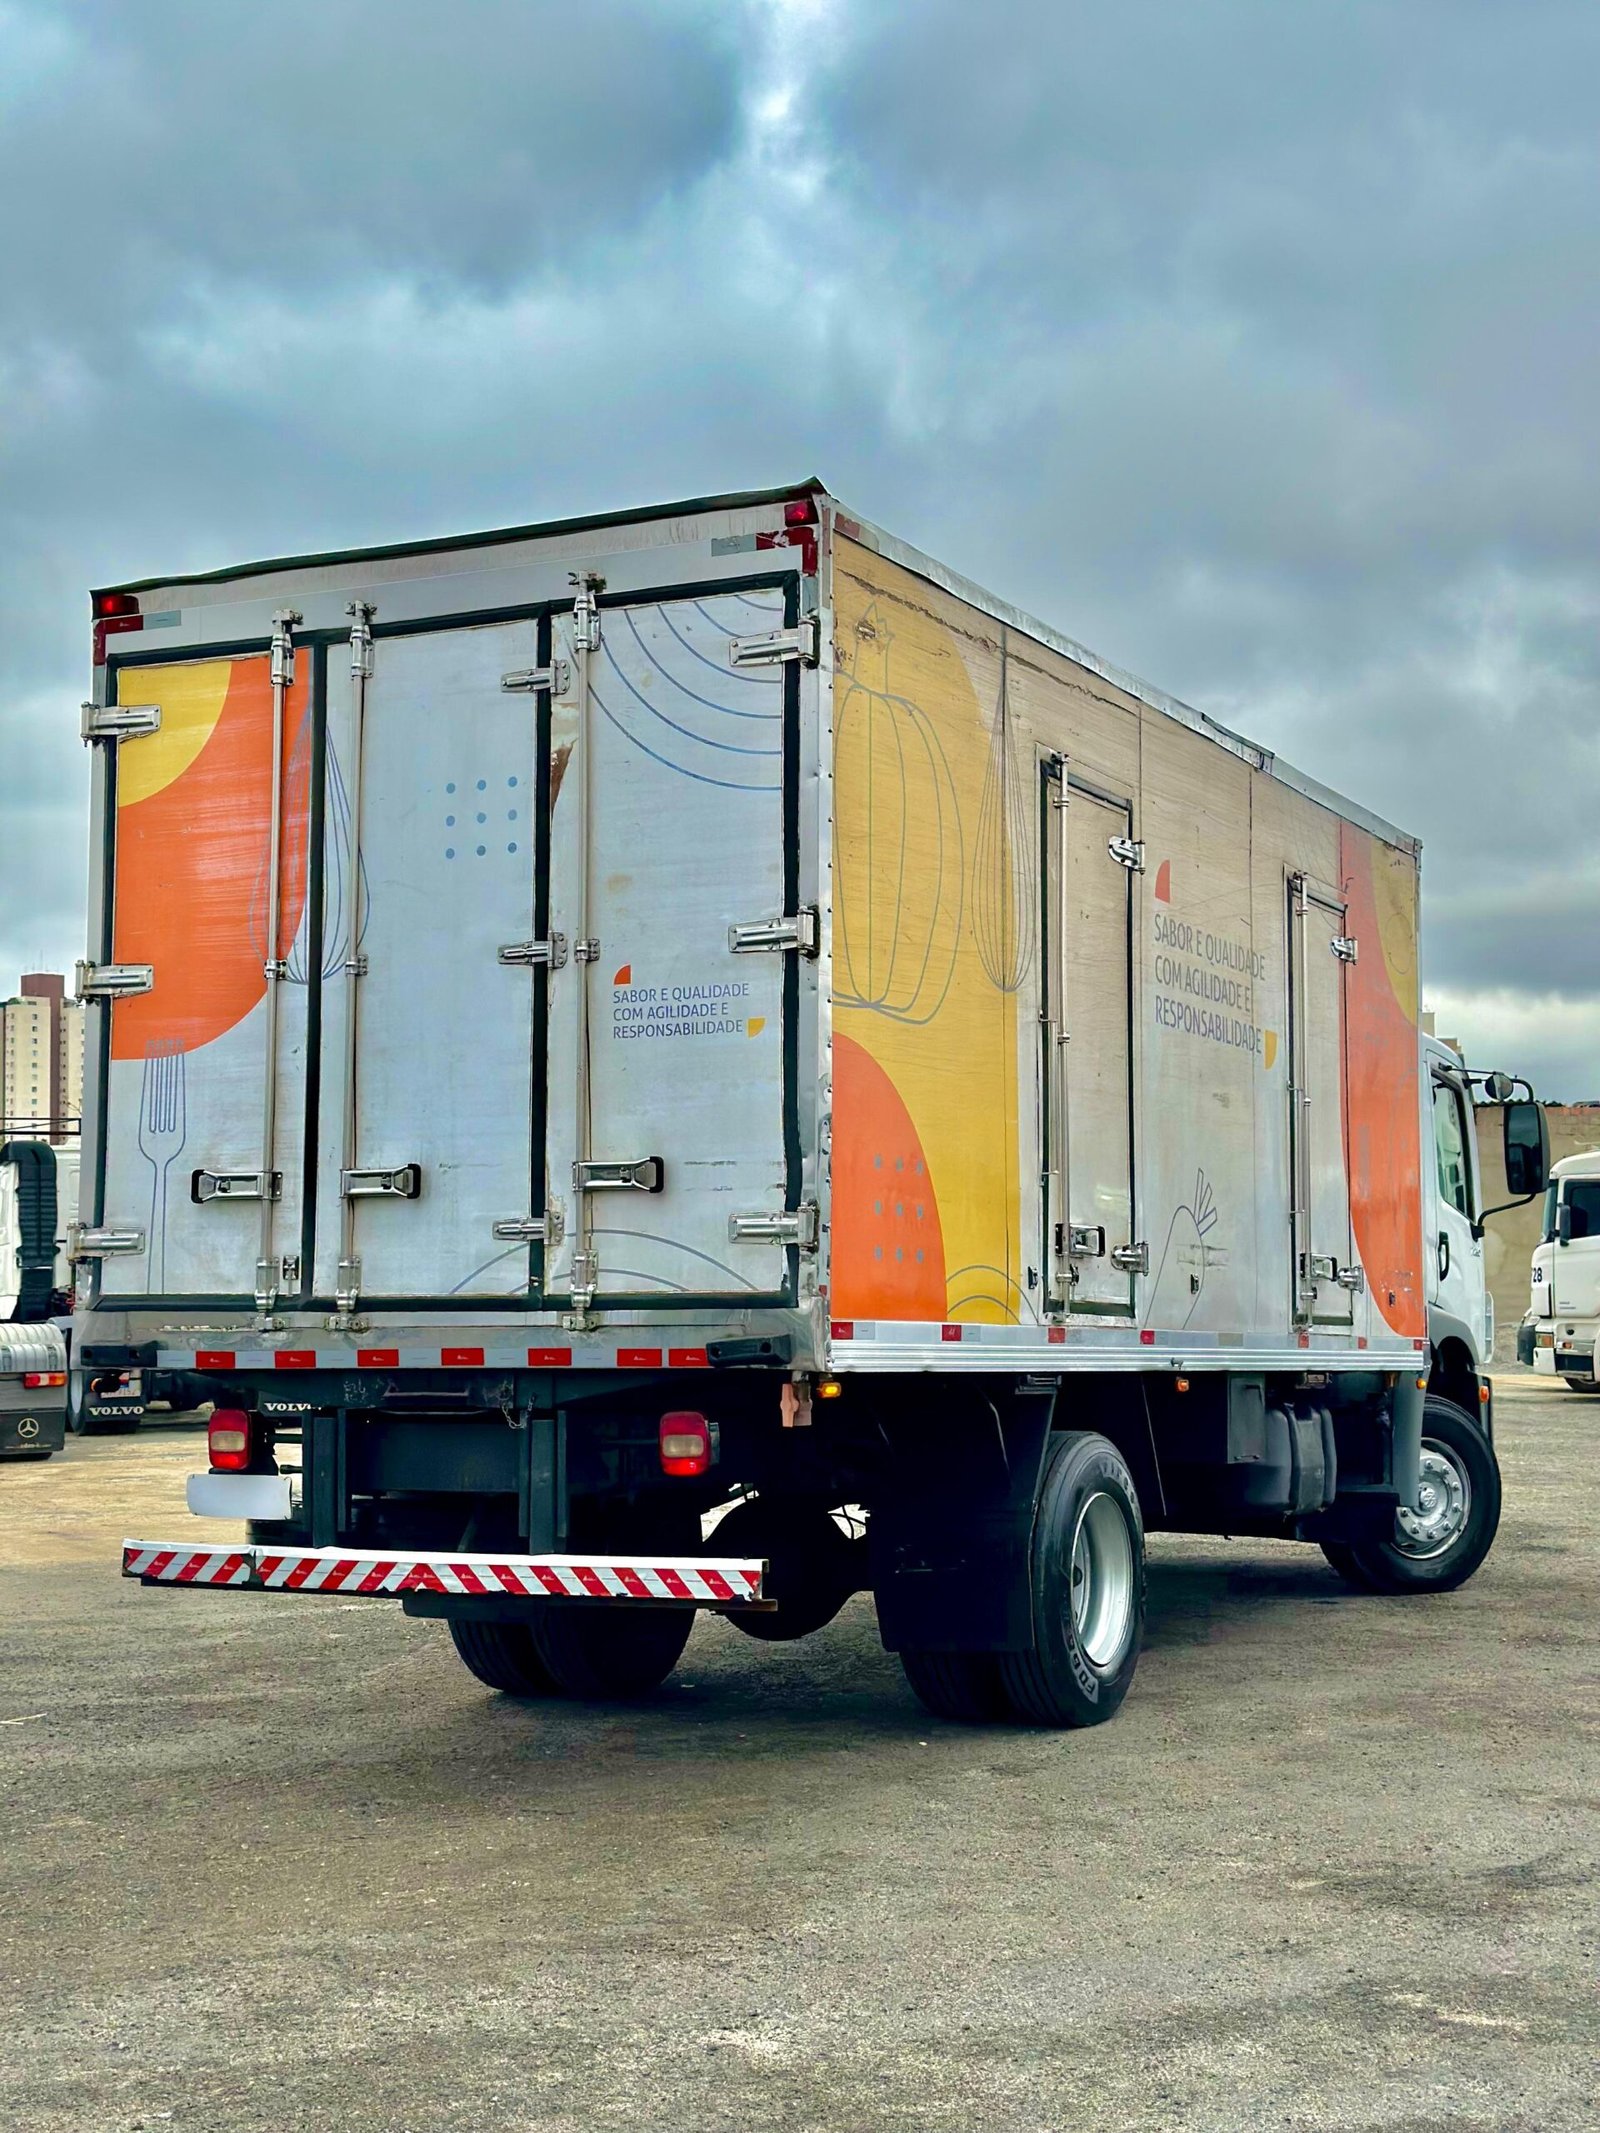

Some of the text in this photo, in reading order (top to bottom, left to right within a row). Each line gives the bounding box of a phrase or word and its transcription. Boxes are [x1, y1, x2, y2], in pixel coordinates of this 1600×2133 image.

[1154, 913, 1266, 981] SABOR E QUALIDADE
[613, 983, 750, 1003] SABOR E QUALIDADE
[1155, 955, 1251, 1013] COM AGILIDADE E
[613, 1002, 729, 1021] COM AGILIDADE E
[613, 1020, 743, 1039] RESPONSABILIDADE
[1155, 995, 1262, 1054] RESPONSABILIDADE
[89, 1406, 145, 1416] VOLVO
